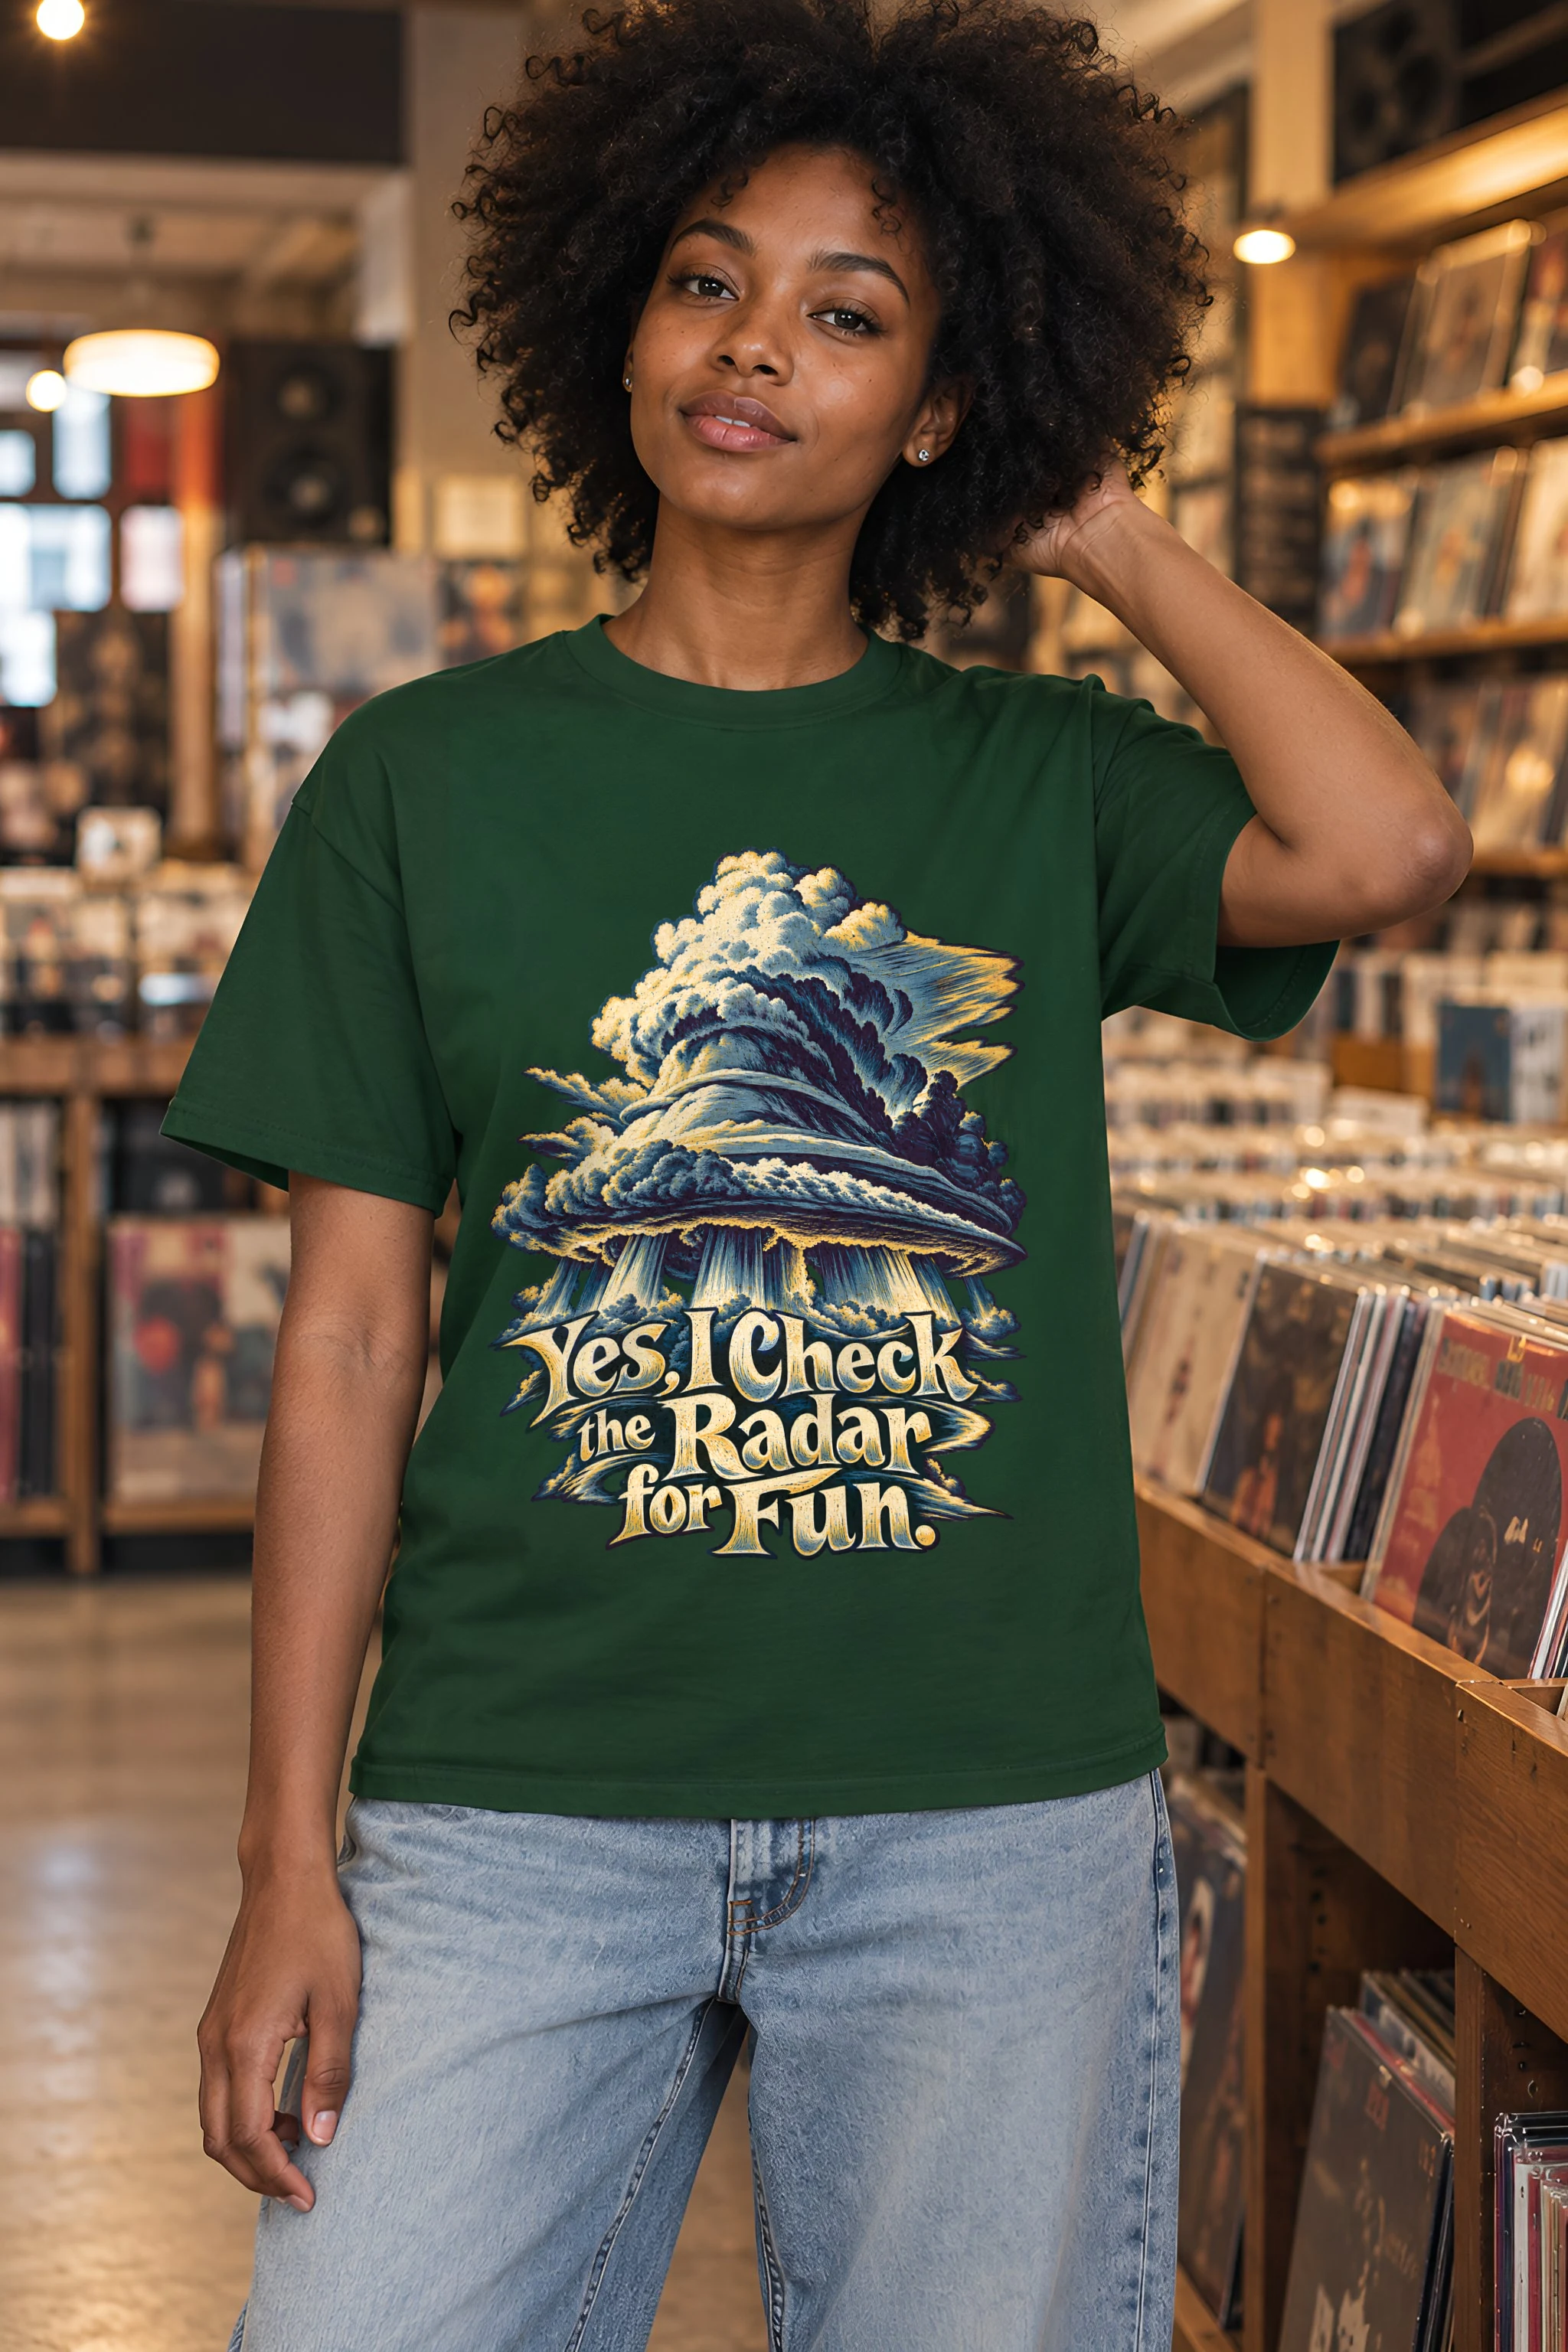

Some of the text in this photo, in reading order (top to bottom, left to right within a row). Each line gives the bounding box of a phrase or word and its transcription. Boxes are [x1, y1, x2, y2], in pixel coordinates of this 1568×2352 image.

[503, 1308, 978, 1427] Yes, I Check
[577, 1393, 932, 1481] the Radar
[609, 1463, 936, 1556] for Fun.
